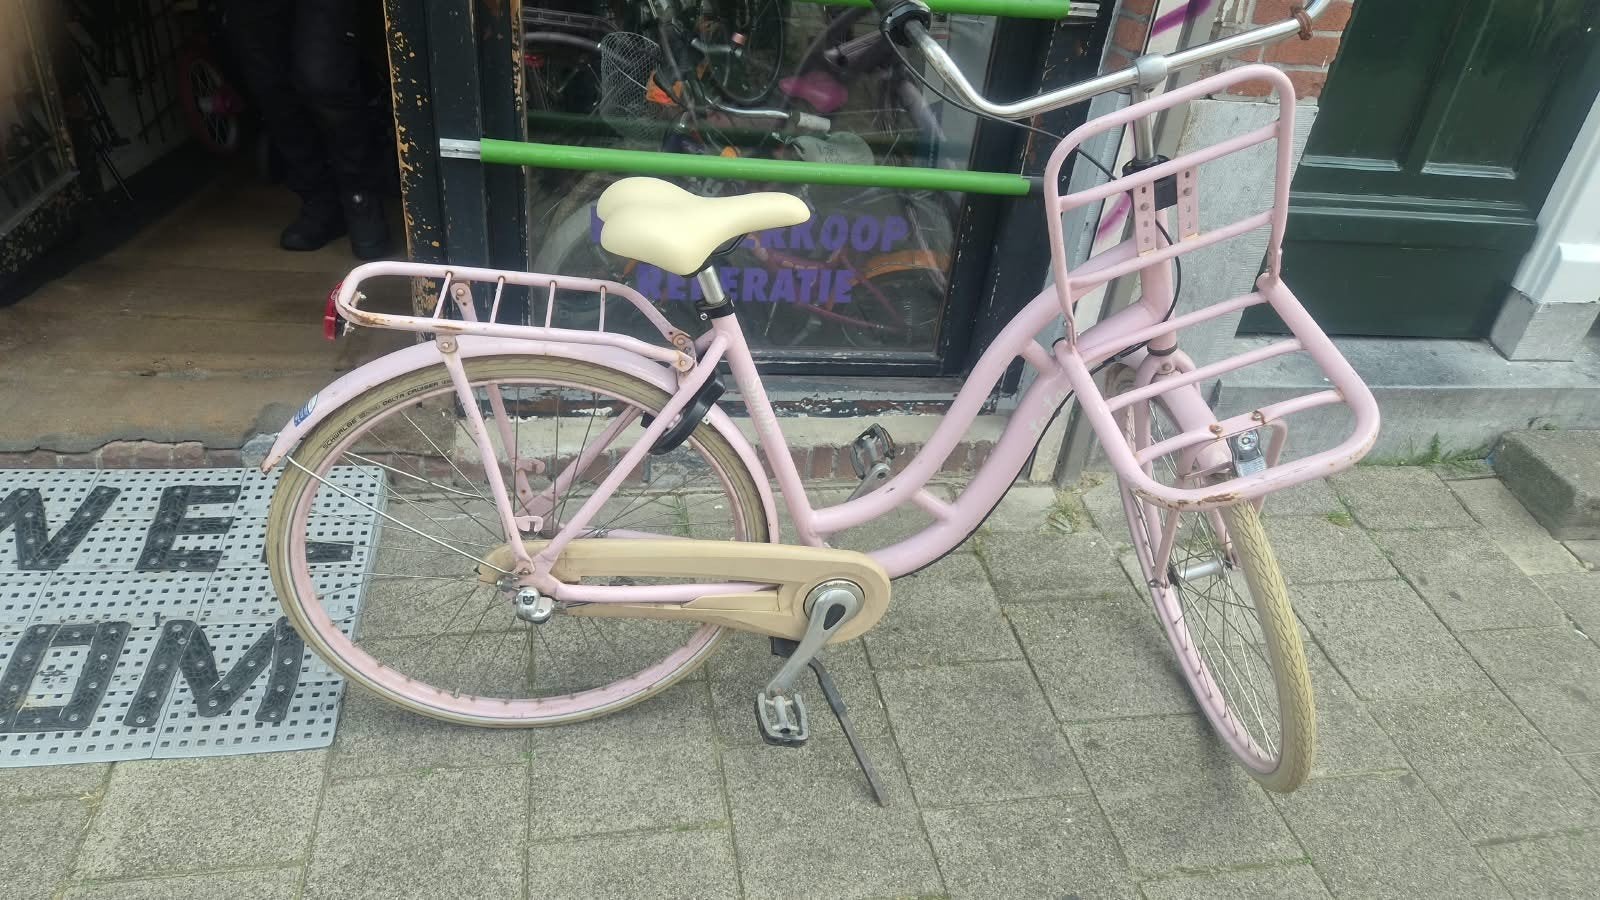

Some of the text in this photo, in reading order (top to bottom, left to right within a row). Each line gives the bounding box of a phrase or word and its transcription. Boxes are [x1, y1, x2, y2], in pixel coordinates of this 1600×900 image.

[322, 420, 357, 449] SCHWALBE
[382, 393, 405, 407] DELTA
[407, 382, 438, 396] CRUISER
